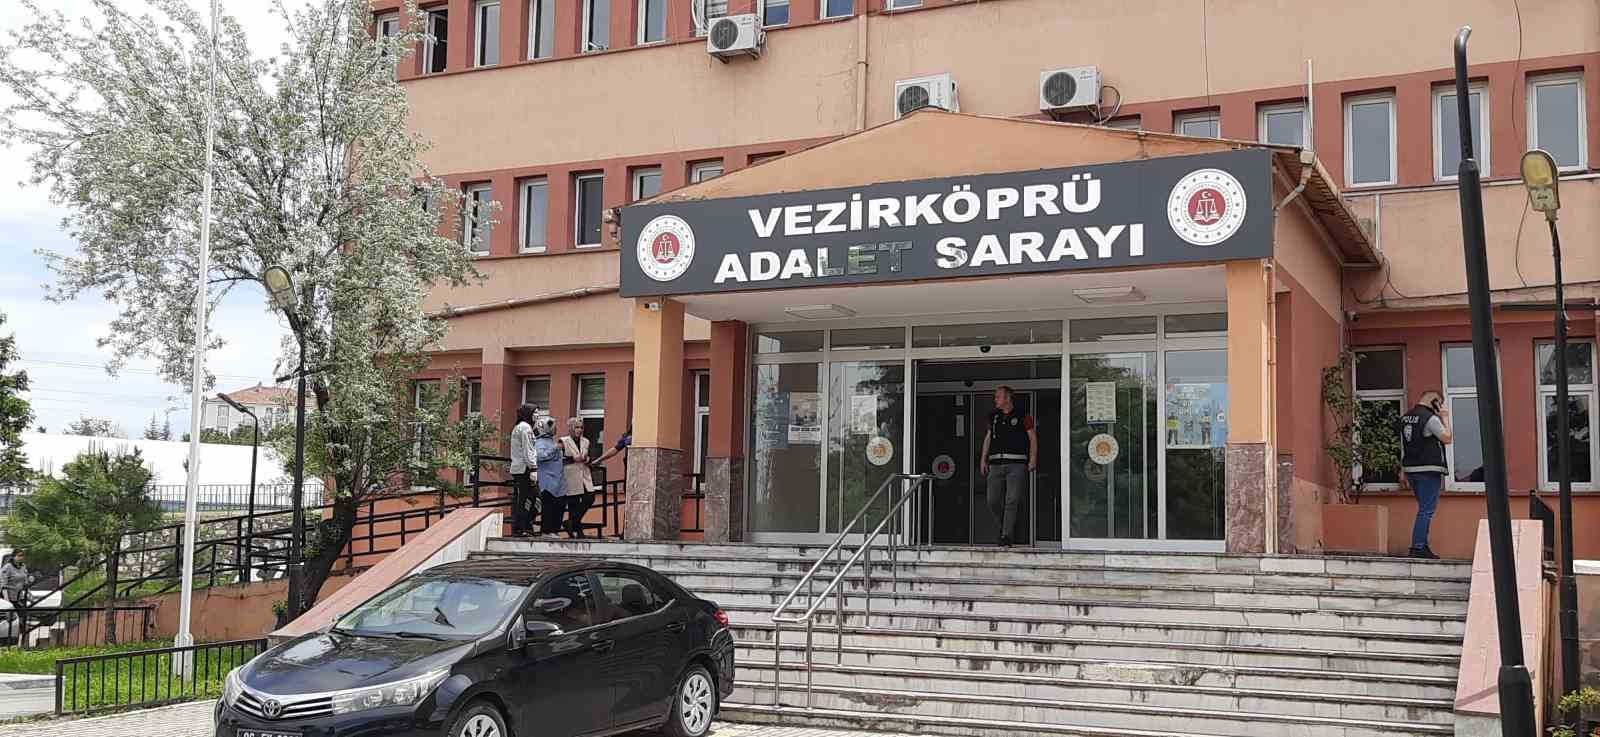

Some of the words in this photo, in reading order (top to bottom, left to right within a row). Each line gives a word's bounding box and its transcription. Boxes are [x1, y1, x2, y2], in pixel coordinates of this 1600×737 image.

[748, 172, 1101, 238] VEZİRKÖPRÜ
[713, 241, 913, 283] ADALET
[936, 223, 1143, 268] SARAYI
